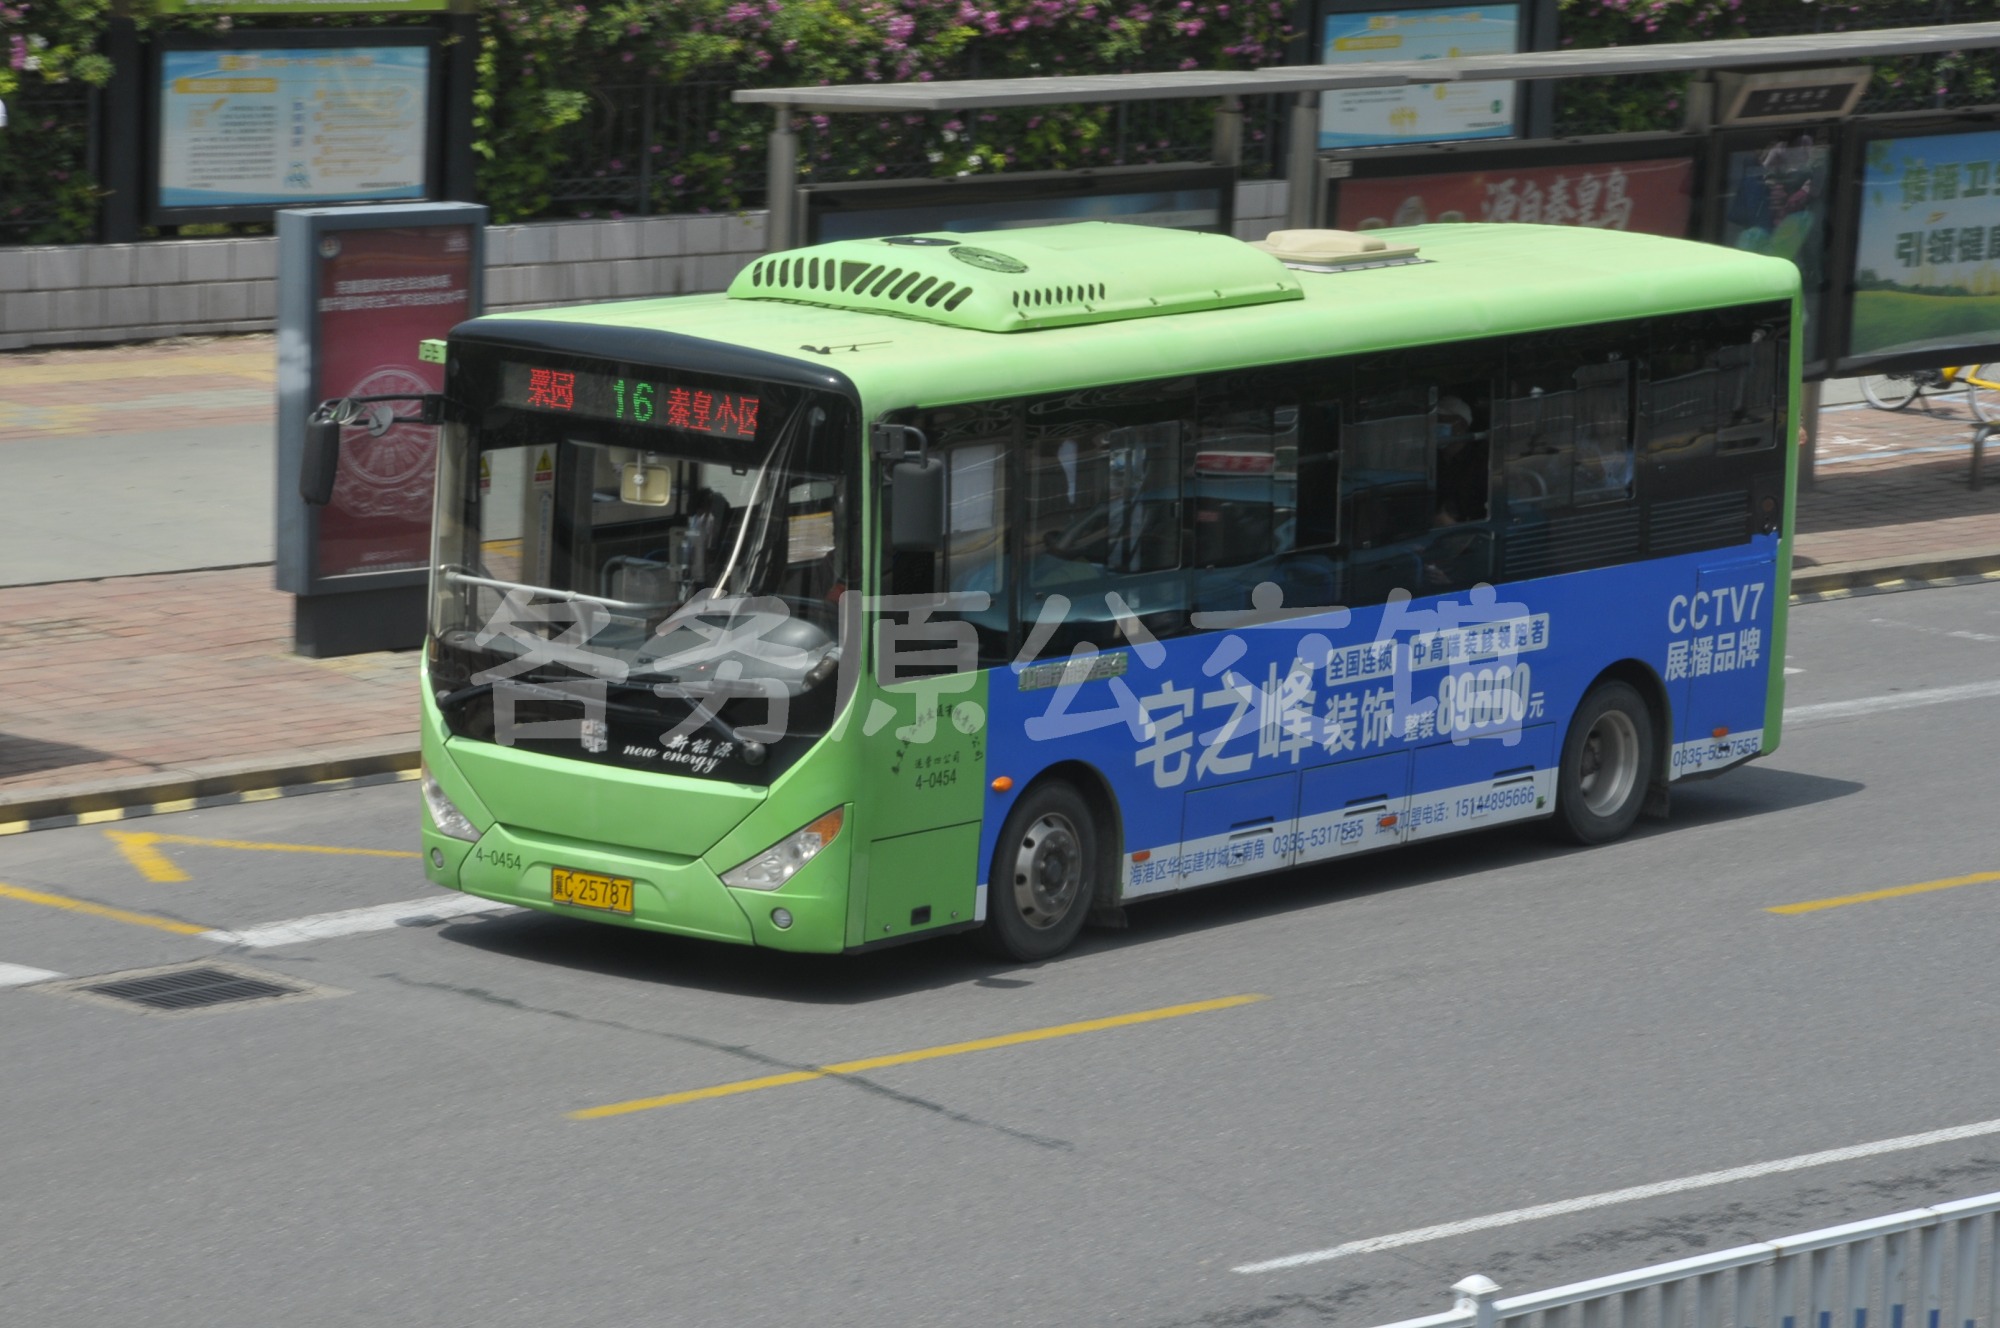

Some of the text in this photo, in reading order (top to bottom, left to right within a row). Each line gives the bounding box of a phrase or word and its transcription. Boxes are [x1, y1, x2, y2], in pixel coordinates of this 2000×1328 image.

[613, 379, 653, 422] 16
[666, 387, 759, 436] 秦皇小区
[1668, 582, 1765, 634] CCTV7
[1329, 619, 1545, 681] 全国连锁 中高端装修领跑者
[1665, 627, 1761, 681] 展播品牌
[666, 734, 733, 758] 新能源
[1135, 657, 1318, 789] 宅之峰
[1322, 686, 1394, 756] 装饰
[623, 744, 721, 774] new energy
[915, 768, 957, 790] 4-0454
[476, 847, 521, 870] 4-0454
